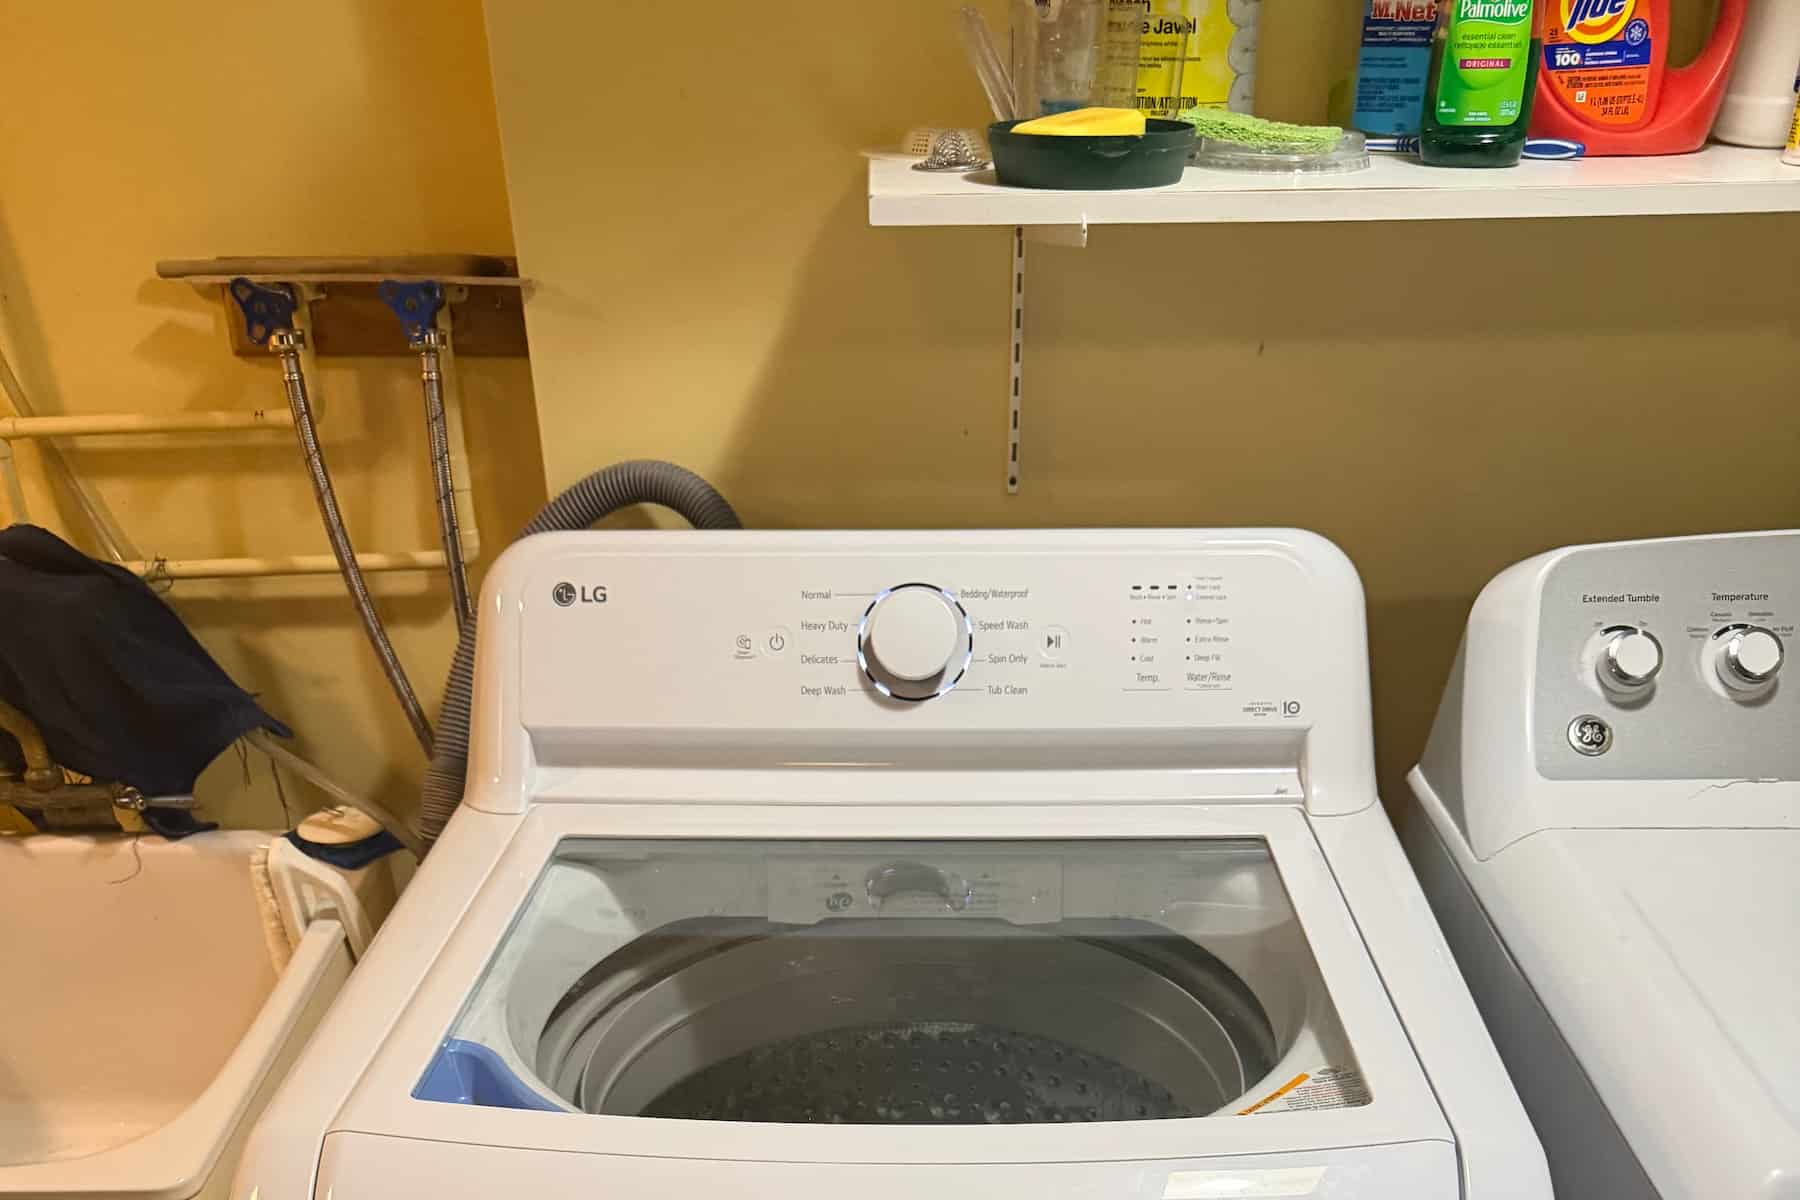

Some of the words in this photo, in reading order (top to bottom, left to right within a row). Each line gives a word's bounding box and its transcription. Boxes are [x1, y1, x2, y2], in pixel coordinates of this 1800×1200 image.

[1460, 0, 1528, 18] Palmolive
[1153, 18, 1197, 34] Javel
[1465, 60, 1505, 68] ORIGINAL
[1555, 53, 1580, 66] 100
[581, 585, 607, 603] LG
[801, 590, 831, 600] Normal
[961, 589, 1029, 600] Bedding/Waterproof
[1582, 593, 1625, 603] Extended
[1626, 593, 1660, 602] Tumble
[1711, 592, 1769, 603] Temperature
[801, 621, 826, 632] Heavy
[828, 621, 848, 632] Duty
[979, 621, 1005, 631] Speed
[1006, 620, 1028, 630] Wash
[801, 655, 839, 665] Delicates
[988, 654, 1007, 664] Spin
[1009, 653, 1027, 664] Only
[1186, 672, 1231, 682] Water/Rinse
[801, 686, 822, 697] Deep
[824, 686, 846, 696] Wash
[988, 685, 1002, 695] Tub
[1004, 685, 1028, 695] Clean
